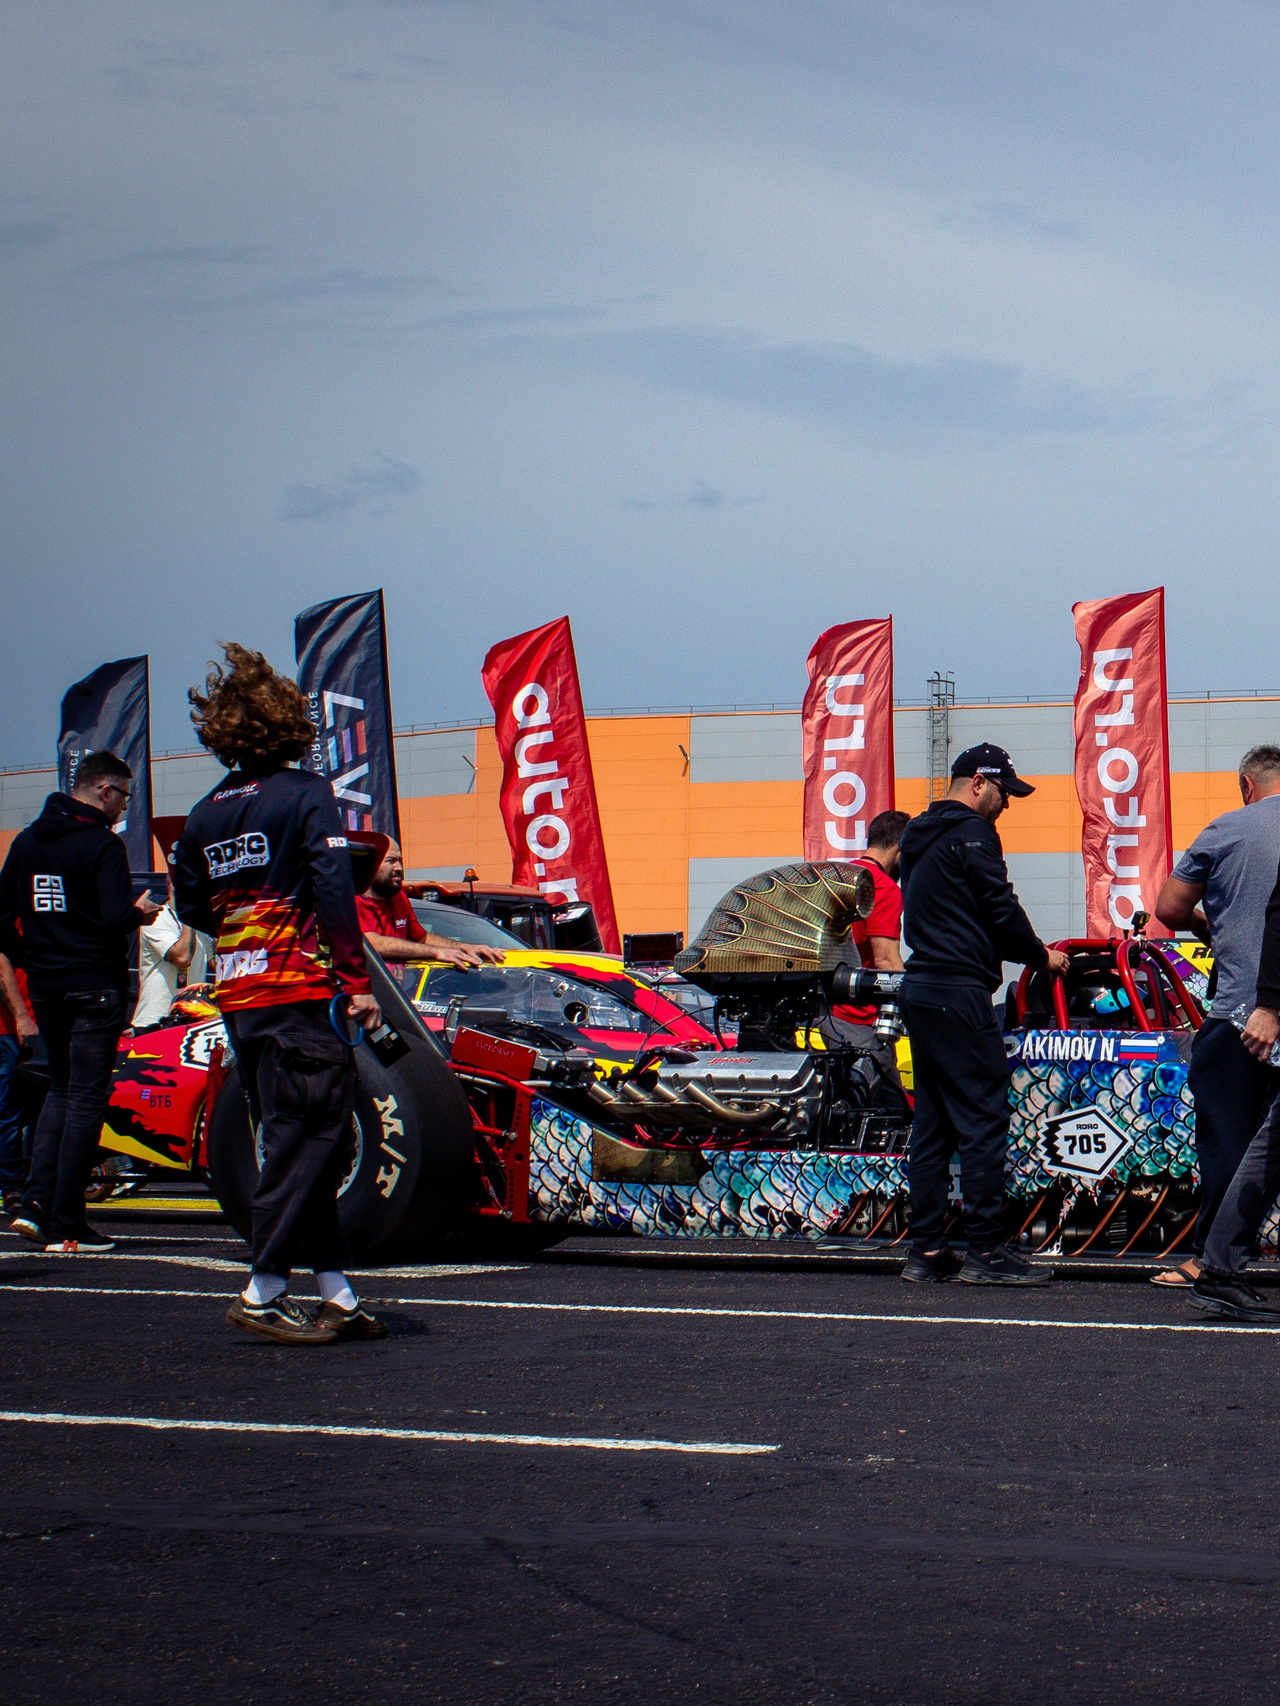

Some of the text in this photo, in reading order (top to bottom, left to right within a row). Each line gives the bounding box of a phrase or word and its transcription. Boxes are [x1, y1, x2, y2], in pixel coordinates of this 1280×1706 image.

[512, 683, 580, 903] auto.r
[1022, 1032, 1118, 1062] AKIMOV N.
[150, 1095, 172, 1108] ВТБ
[372, 1094, 408, 1199] M/T
[1064, 1133, 1107, 1155] 705
